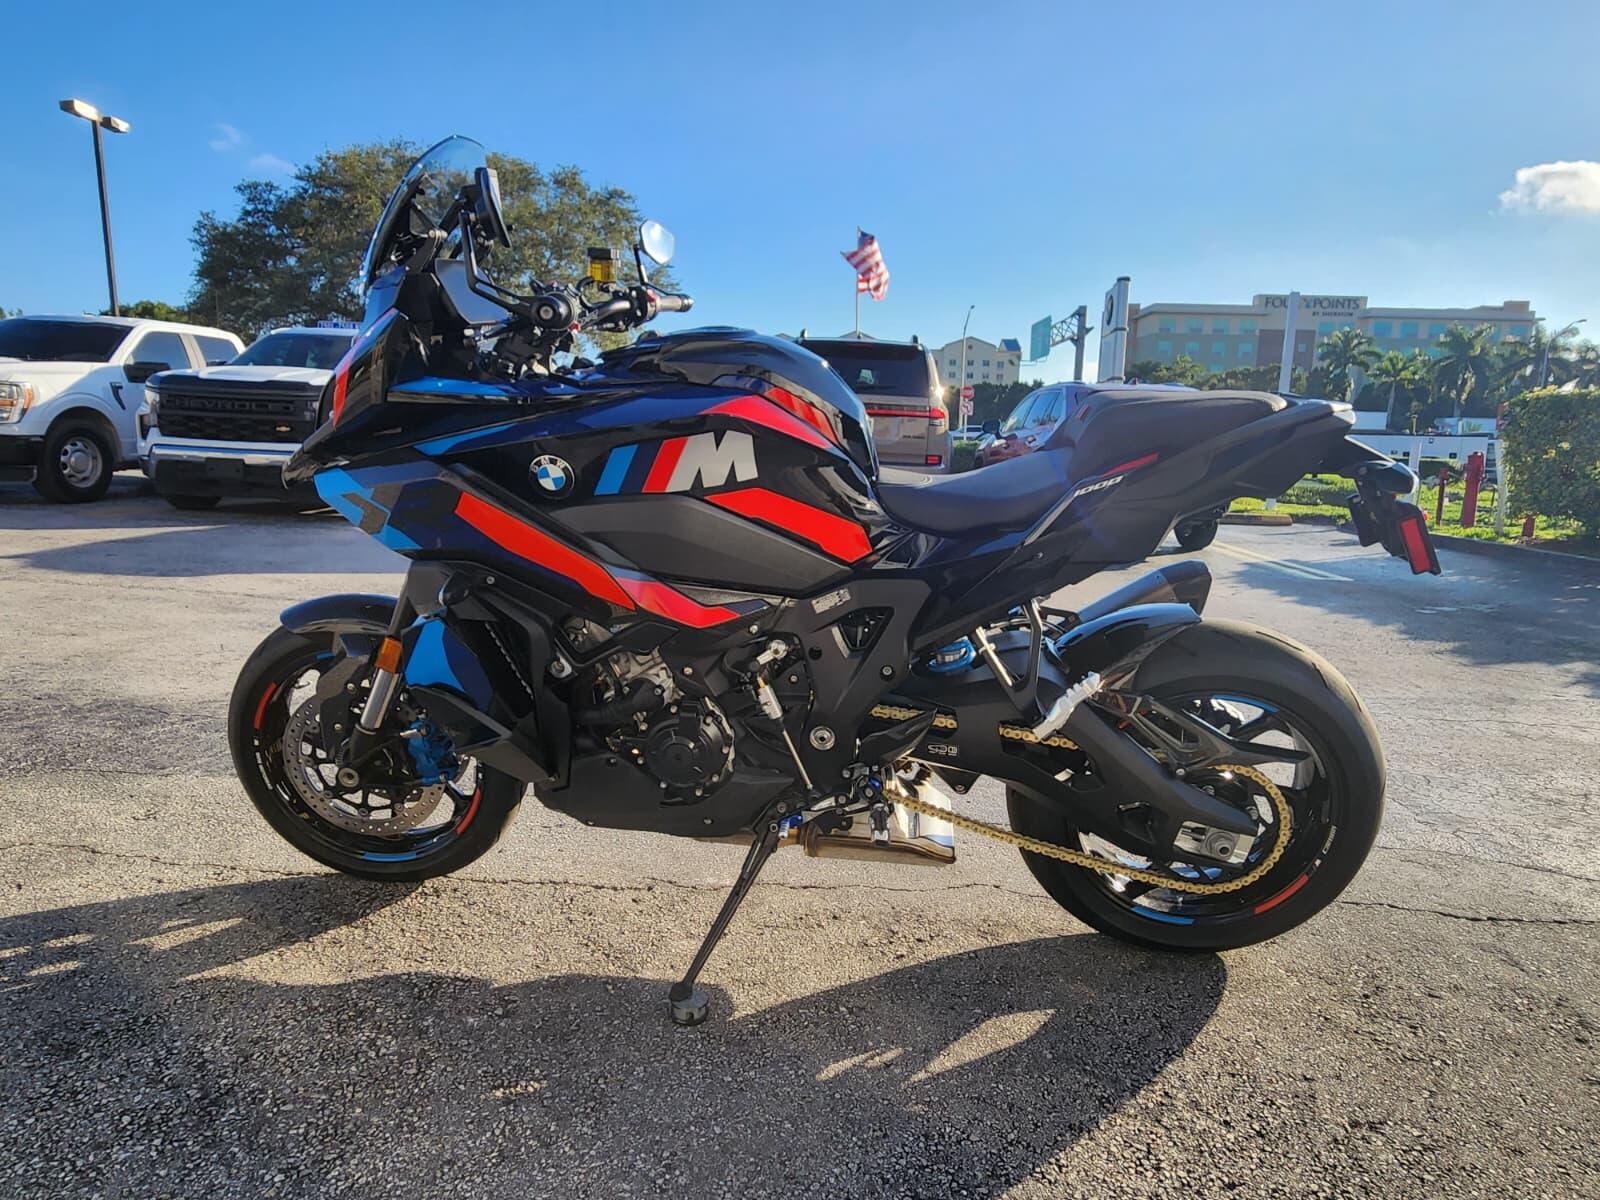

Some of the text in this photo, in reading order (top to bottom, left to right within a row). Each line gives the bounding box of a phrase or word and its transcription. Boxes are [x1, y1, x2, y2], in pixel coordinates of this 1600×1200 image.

[1264, 296, 1360, 310] FOU POINTS
[530, 456, 566, 473] BMW
[664, 430, 759, 493] M
